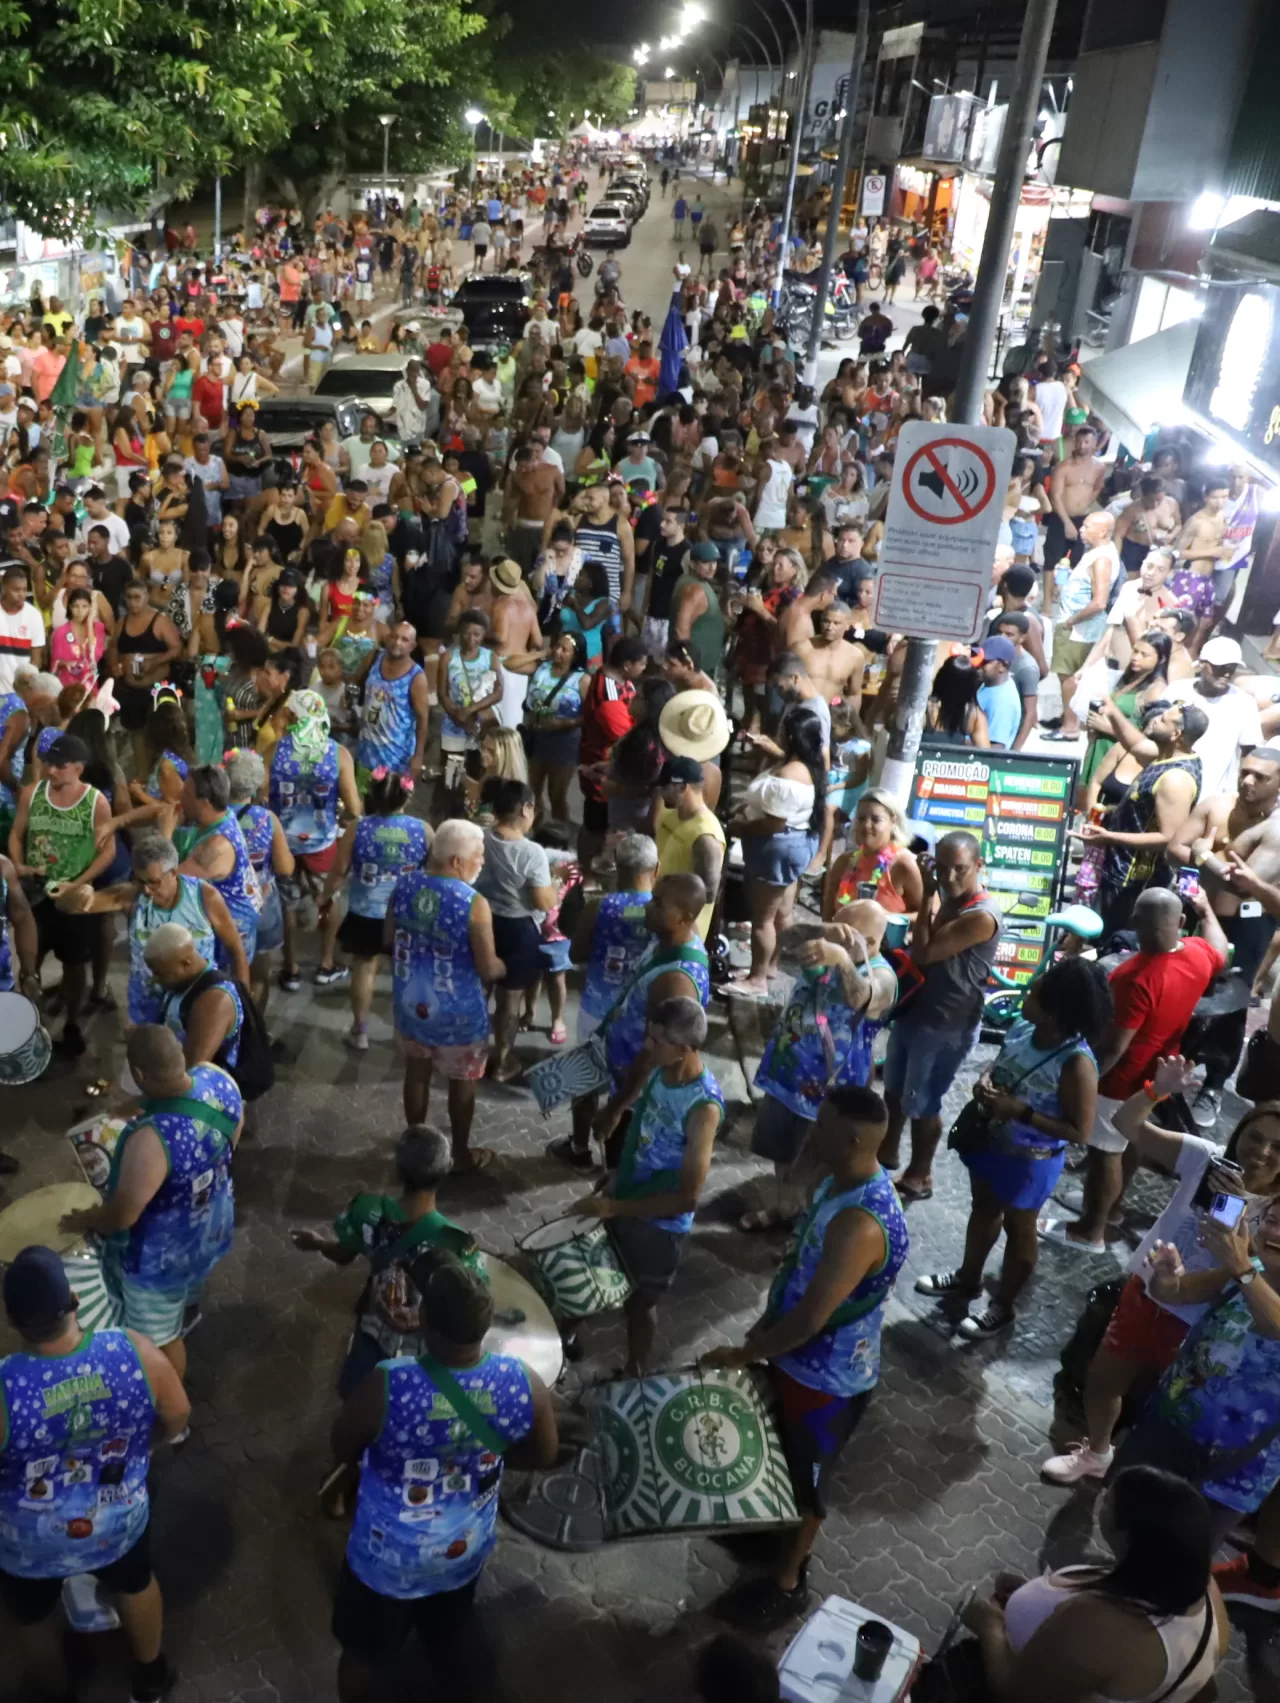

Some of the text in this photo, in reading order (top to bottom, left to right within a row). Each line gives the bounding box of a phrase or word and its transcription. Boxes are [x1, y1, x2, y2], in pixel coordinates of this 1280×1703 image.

[923, 762, 989, 781] PROMOÇÃO
[997, 822, 1034, 836] CORONA
[994, 846, 1032, 861] SPATEN
[41, 1372, 104, 1408] BATERIA
[673, 1455, 756, 1488] BLOCANA
